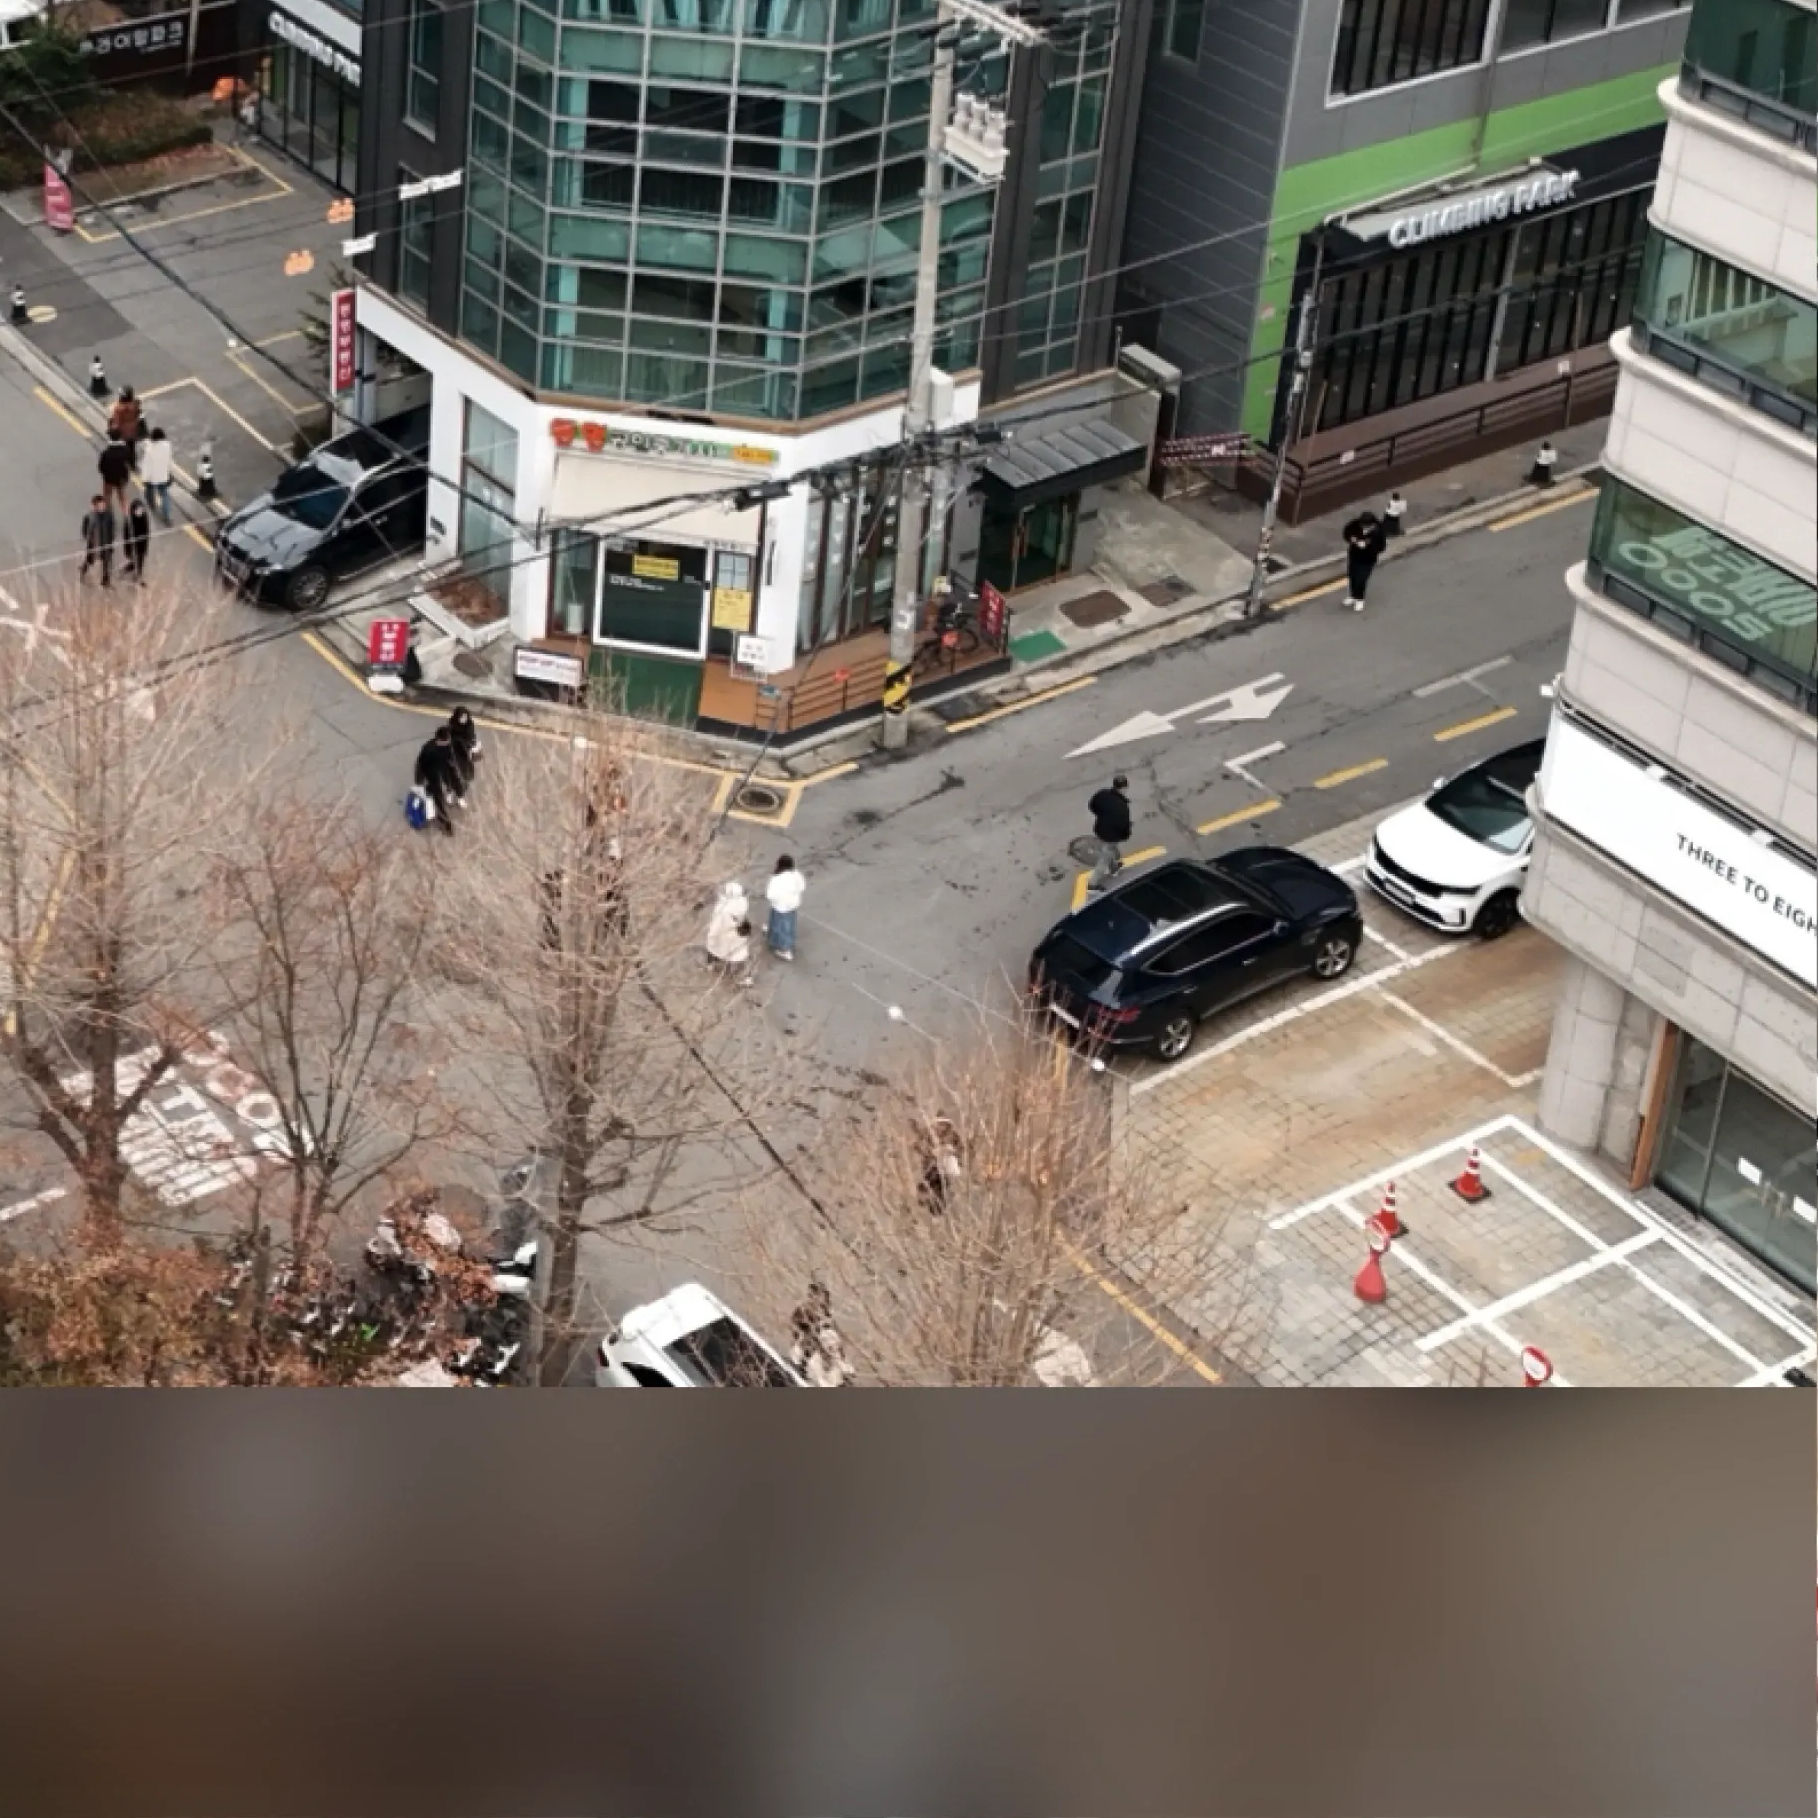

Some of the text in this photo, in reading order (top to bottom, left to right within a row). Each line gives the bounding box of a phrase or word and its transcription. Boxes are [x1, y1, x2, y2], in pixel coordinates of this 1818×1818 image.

[1511, 169, 1581, 215] PARK
[1677, 832, 1738, 885] THREE
[1743, 875, 1770, 903] TO
